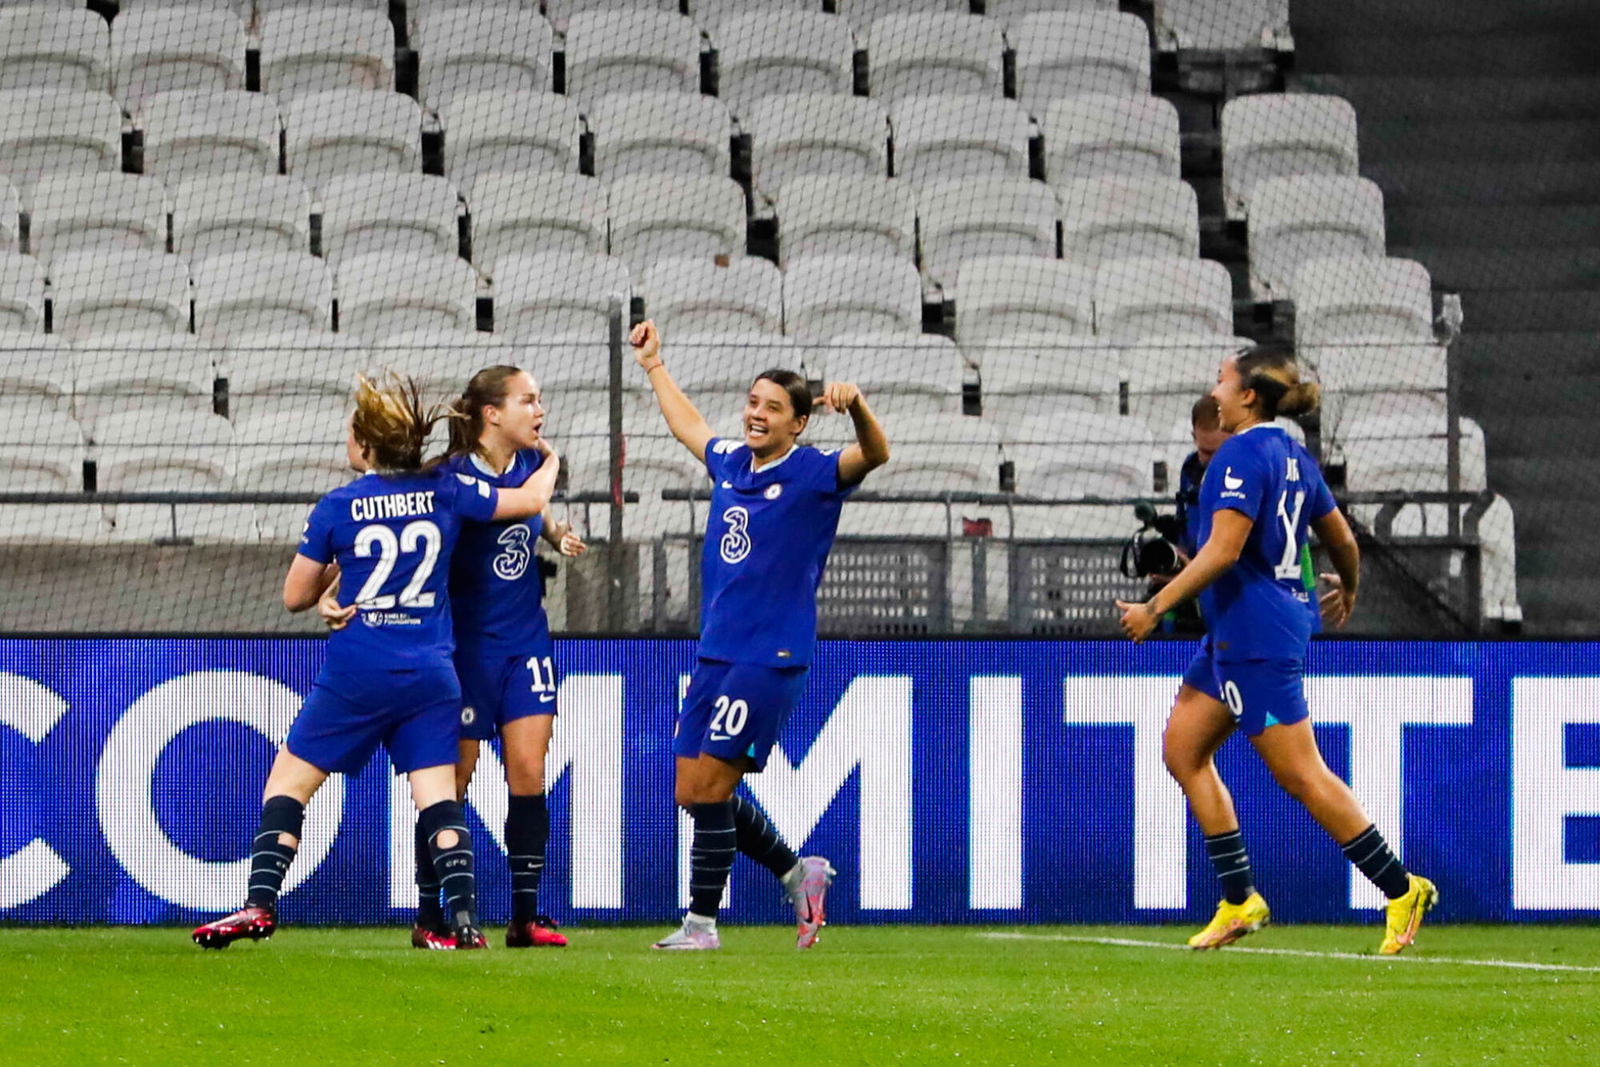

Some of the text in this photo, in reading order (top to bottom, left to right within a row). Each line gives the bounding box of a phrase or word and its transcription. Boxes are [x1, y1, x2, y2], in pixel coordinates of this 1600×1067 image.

[351, 491, 434, 521] CUTHBERT
[354, 520, 441, 609] 22
[526, 656, 556, 692] 11
[710, 695, 748, 736] 20
